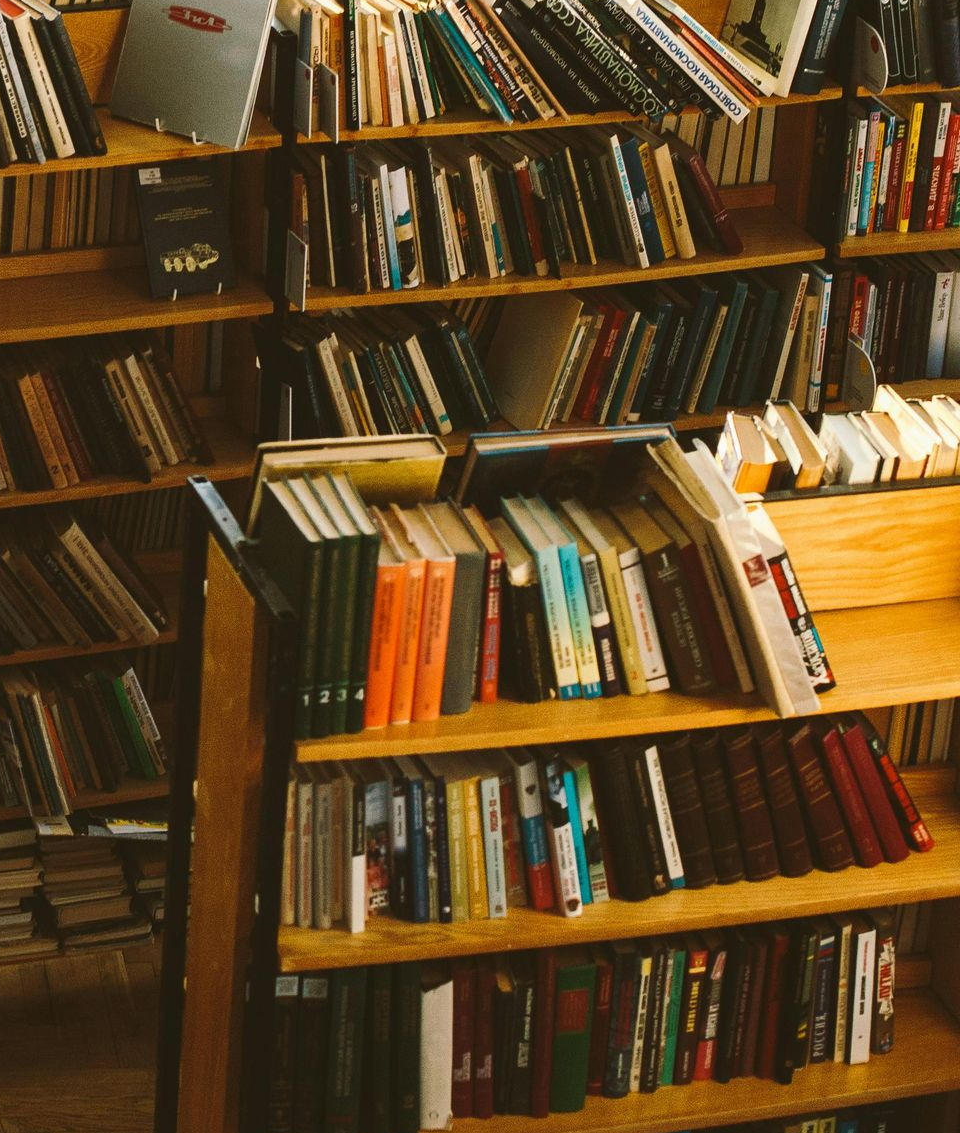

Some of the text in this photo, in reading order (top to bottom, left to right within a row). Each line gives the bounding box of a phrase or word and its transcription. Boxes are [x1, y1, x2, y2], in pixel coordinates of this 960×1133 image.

[528, 26, 600, 105] ДОРОГА НА КОСМОДРОМ
[571, 18, 664, 121] КОСМОНАВТИКА
[632, 5, 742, 117] СОВЕТСКАЯ КОСМОНАВТИКА
[650, 50, 677, 77] STARS
[928, 163, 941, 200] ДИКУЛЬ
[303, 694, 309, 706] 1
[319, 691, 330, 703] 2
[336, 689, 347, 701] 3
[355, 688, 364, 700] 4
